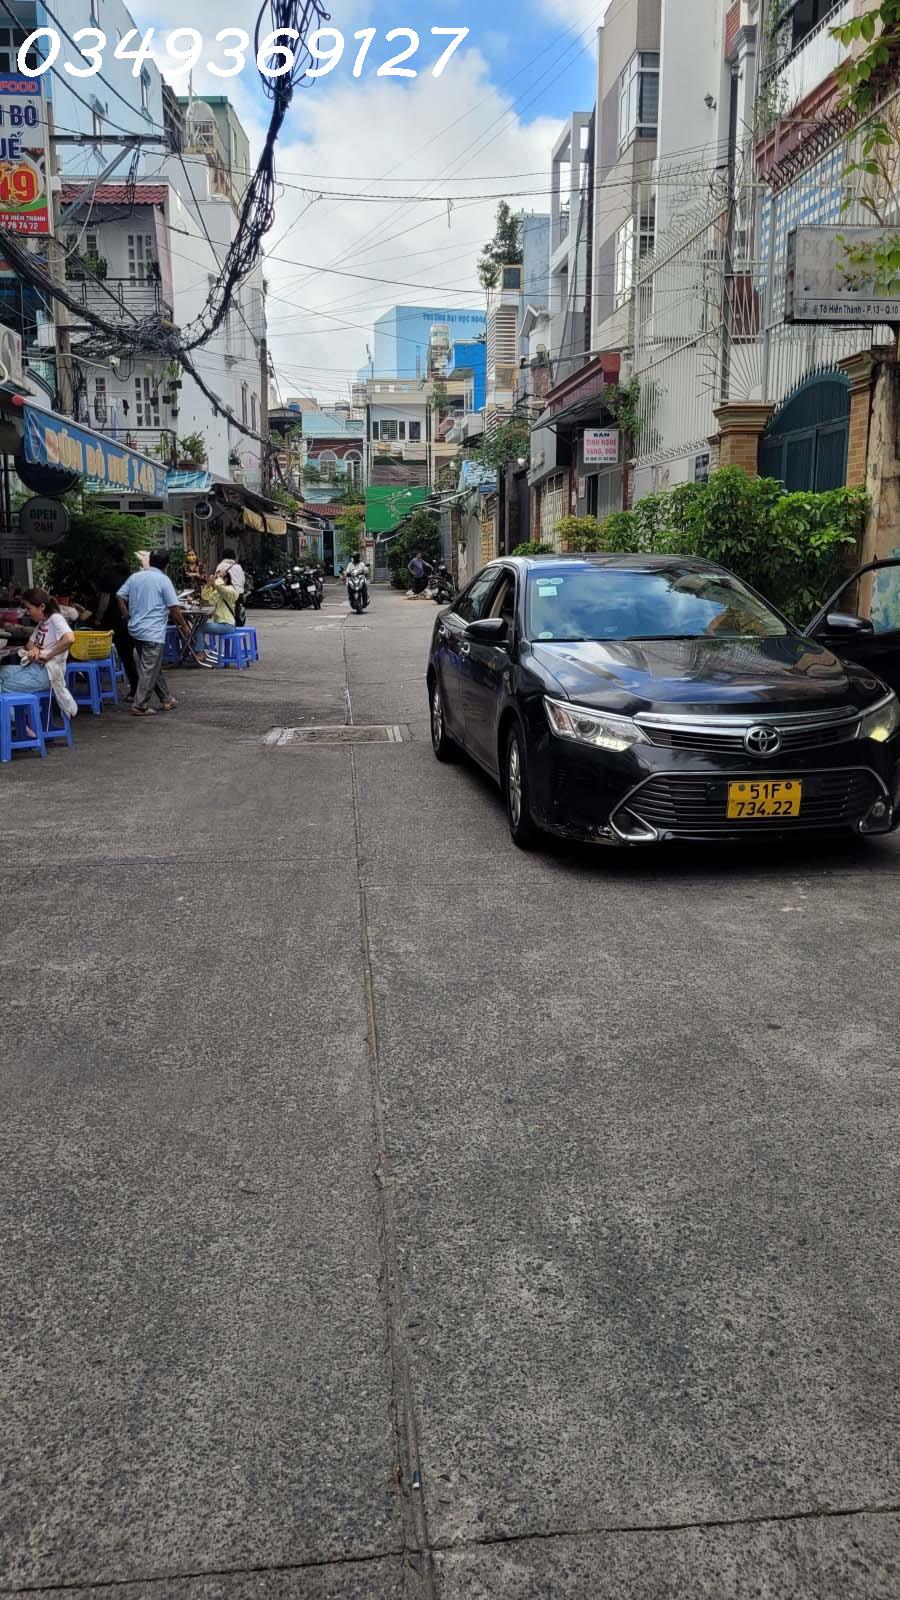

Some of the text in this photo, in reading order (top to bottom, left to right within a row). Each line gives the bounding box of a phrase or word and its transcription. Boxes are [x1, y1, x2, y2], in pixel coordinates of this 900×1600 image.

[10, 100, 38, 126] BÒ
[750, 784, 781, 799] 51F
[736, 801, 793, 816] 734.22
